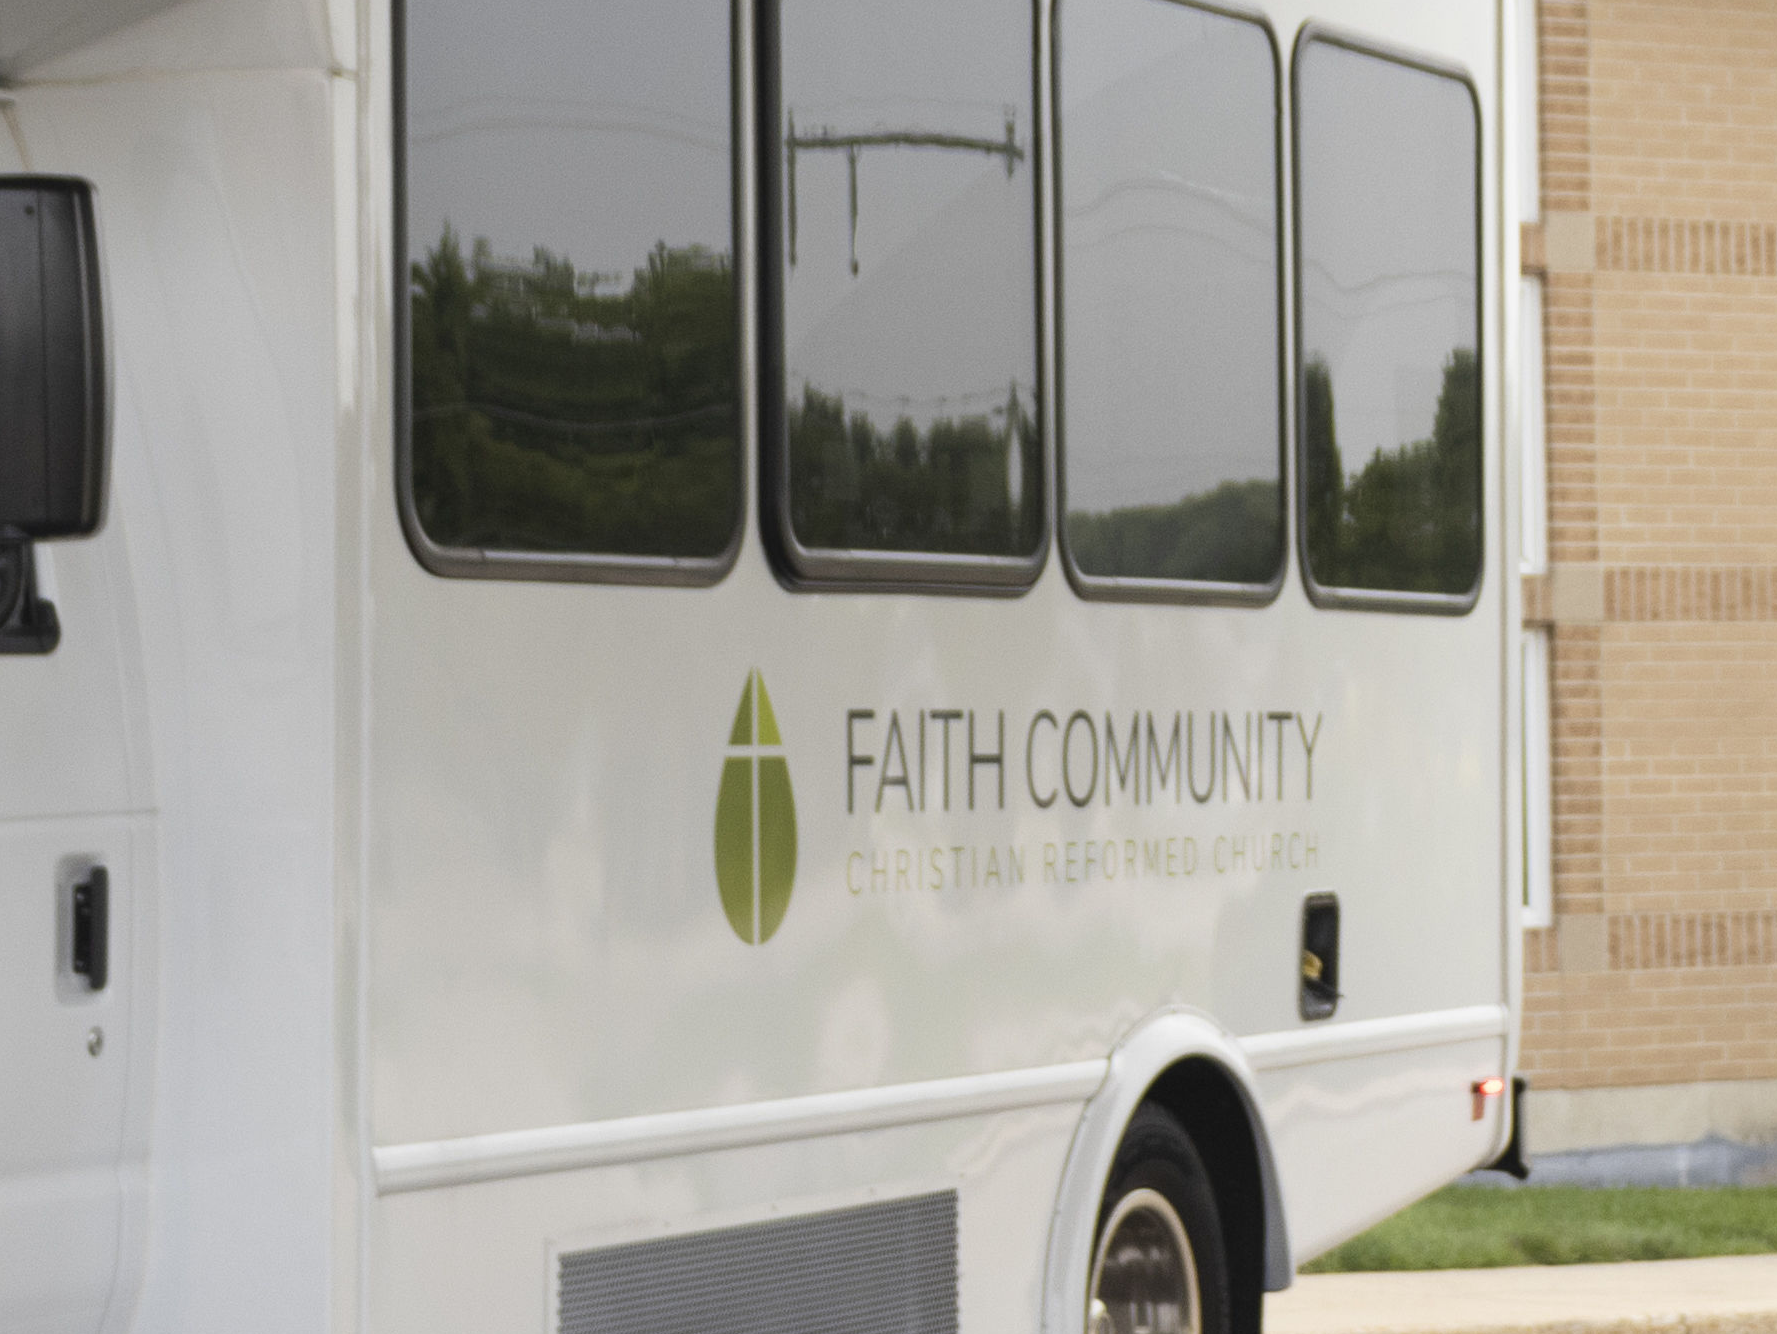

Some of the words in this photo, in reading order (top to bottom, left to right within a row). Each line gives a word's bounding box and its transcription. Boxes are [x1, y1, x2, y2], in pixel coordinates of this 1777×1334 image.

[846, 709, 1005, 813] FAITH
[1025, 709, 1322, 808] COMMUNITY
[846, 845, 1024, 896] CHRISTIAN
[1043, 836, 1198, 883] REFORMED
[1213, 831, 1320, 874] CHURCH
